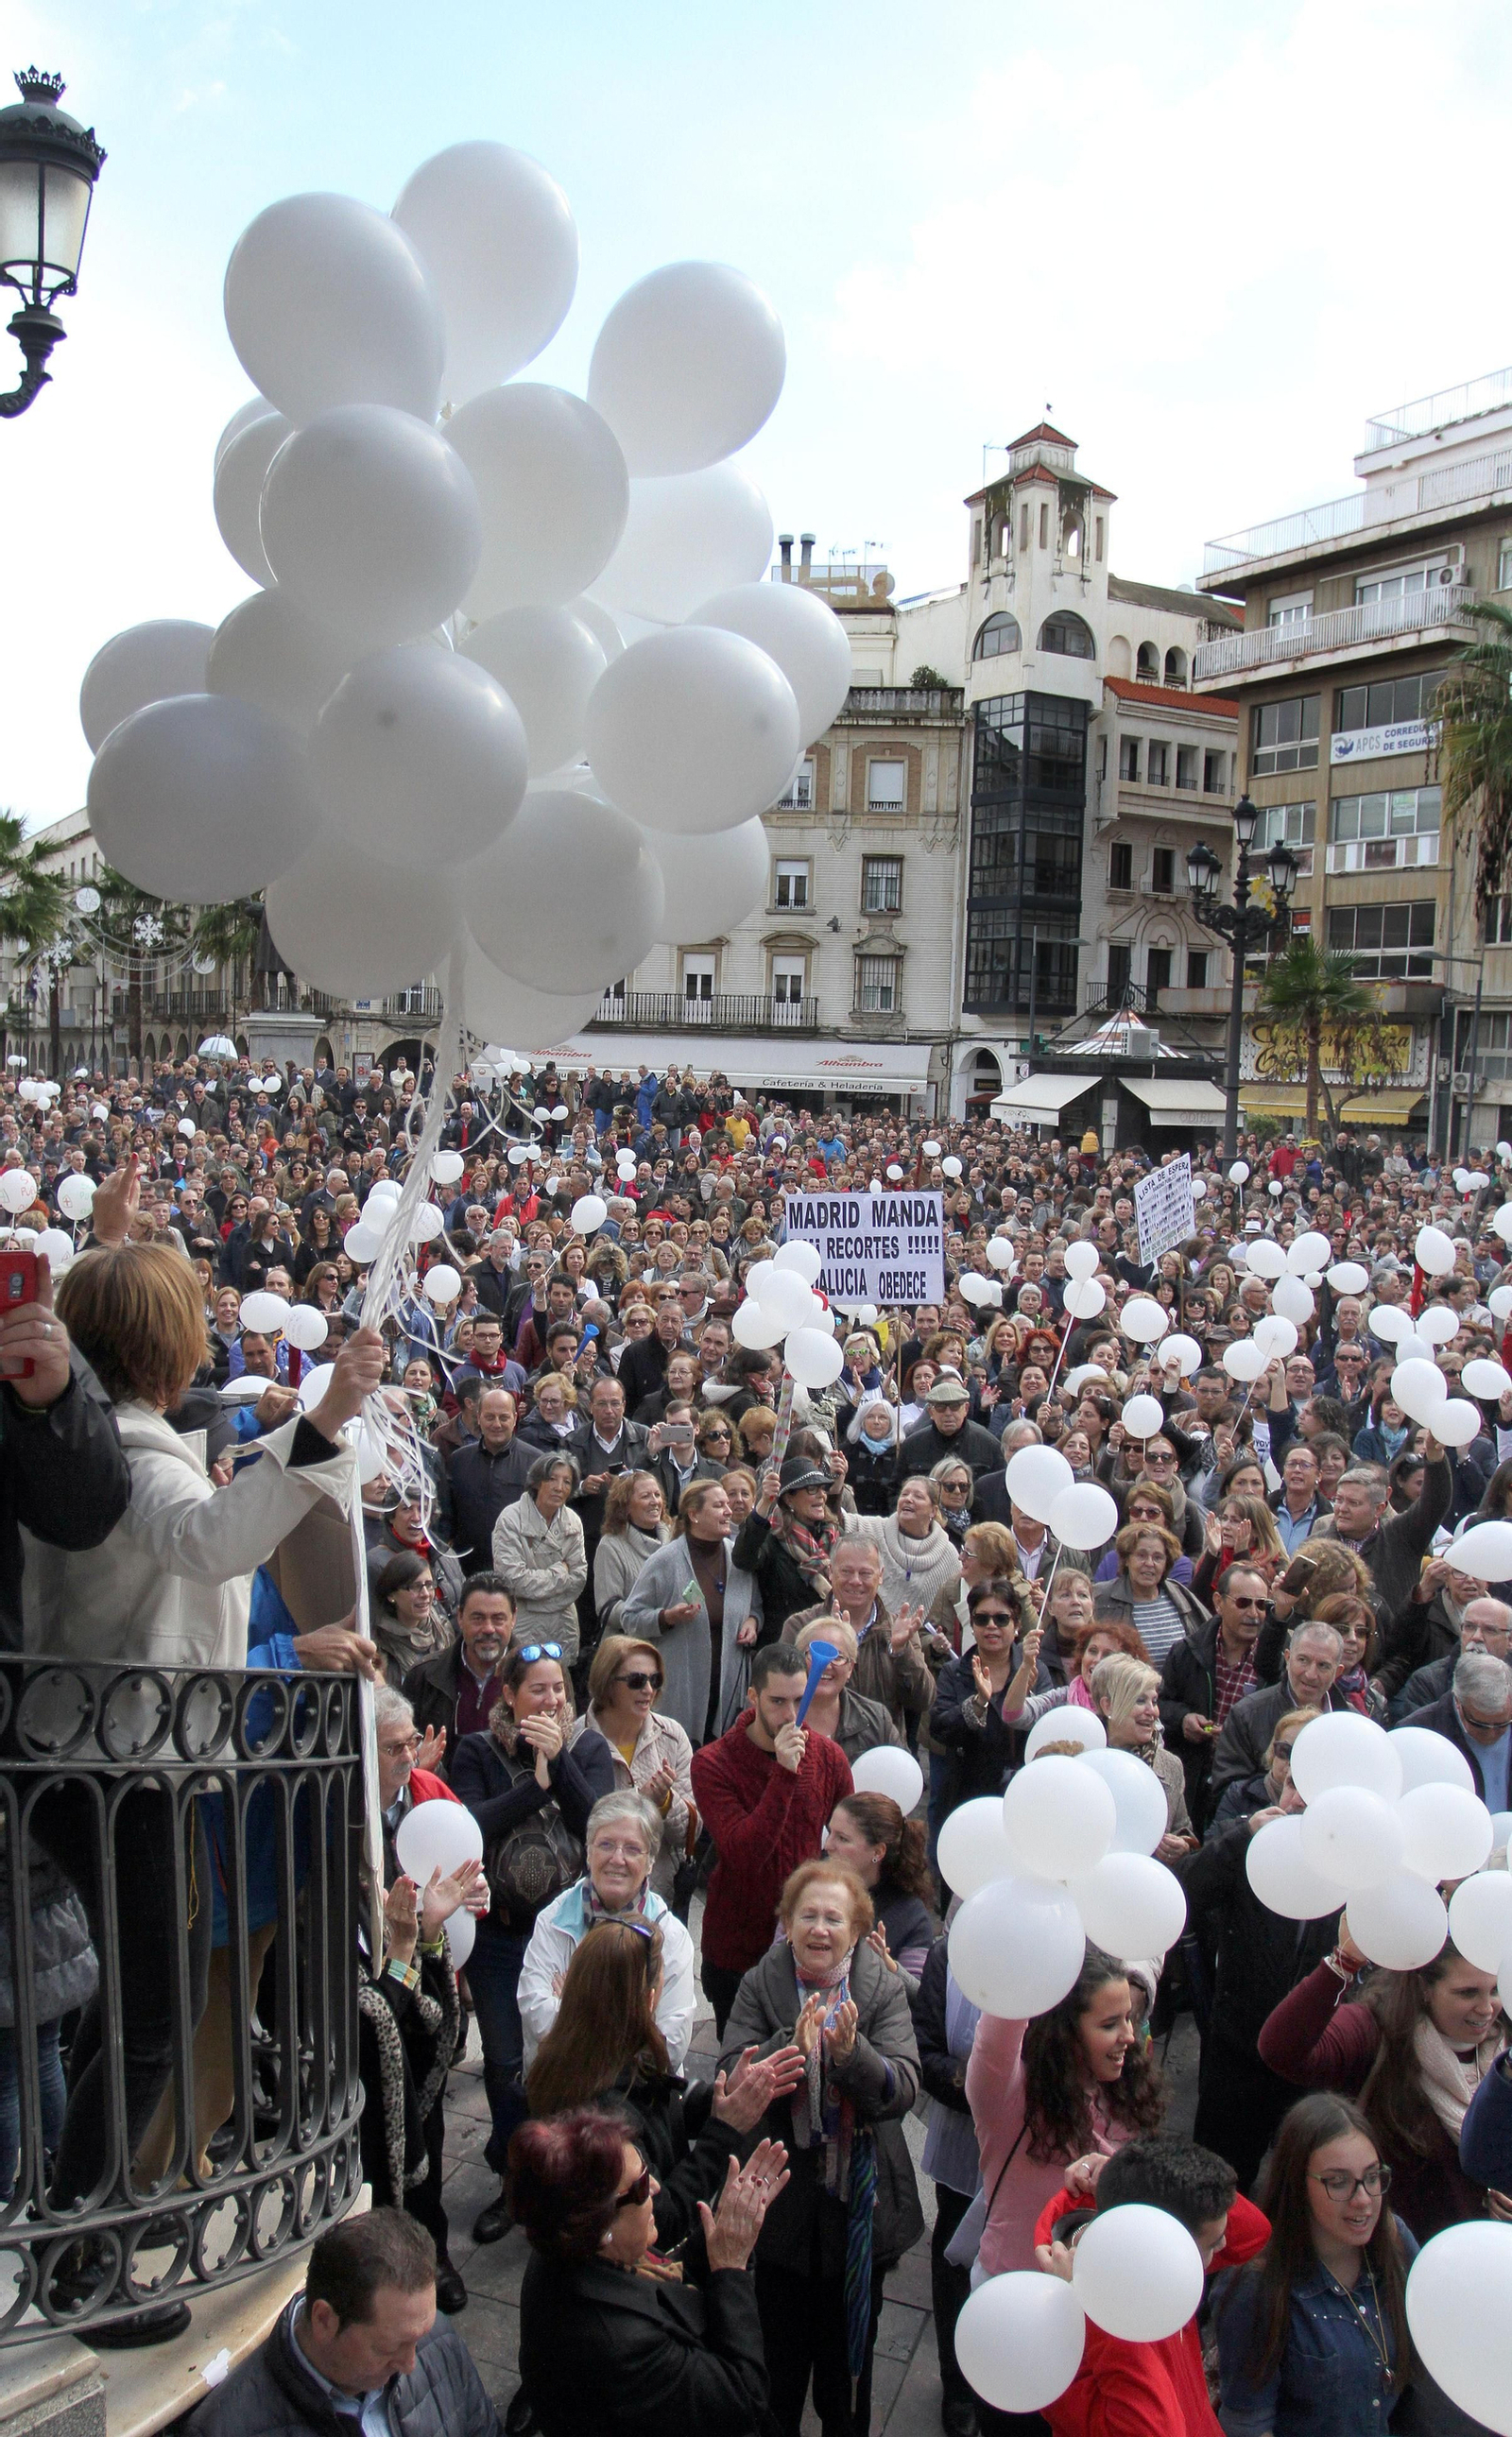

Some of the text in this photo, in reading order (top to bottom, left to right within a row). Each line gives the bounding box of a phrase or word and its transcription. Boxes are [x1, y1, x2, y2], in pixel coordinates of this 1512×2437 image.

[1356, 736, 1380, 753] APCS
[1383, 743, 1395, 751] DE
[816, 1059, 884, 1068] Alhambra
[762, 1078, 814, 1088] Cafetería
[831, 1082, 884, 1091] Heladería
[1138, 1162, 1188, 1201] LISTA DE ESPERA
[789, 1200, 939, 1229] MADRID MANDA
[827, 1236, 899, 1259] RECORTES
[908, 1236, 939, 1254] !!!!!
[879, 1271, 927, 1299] OBEDECE
